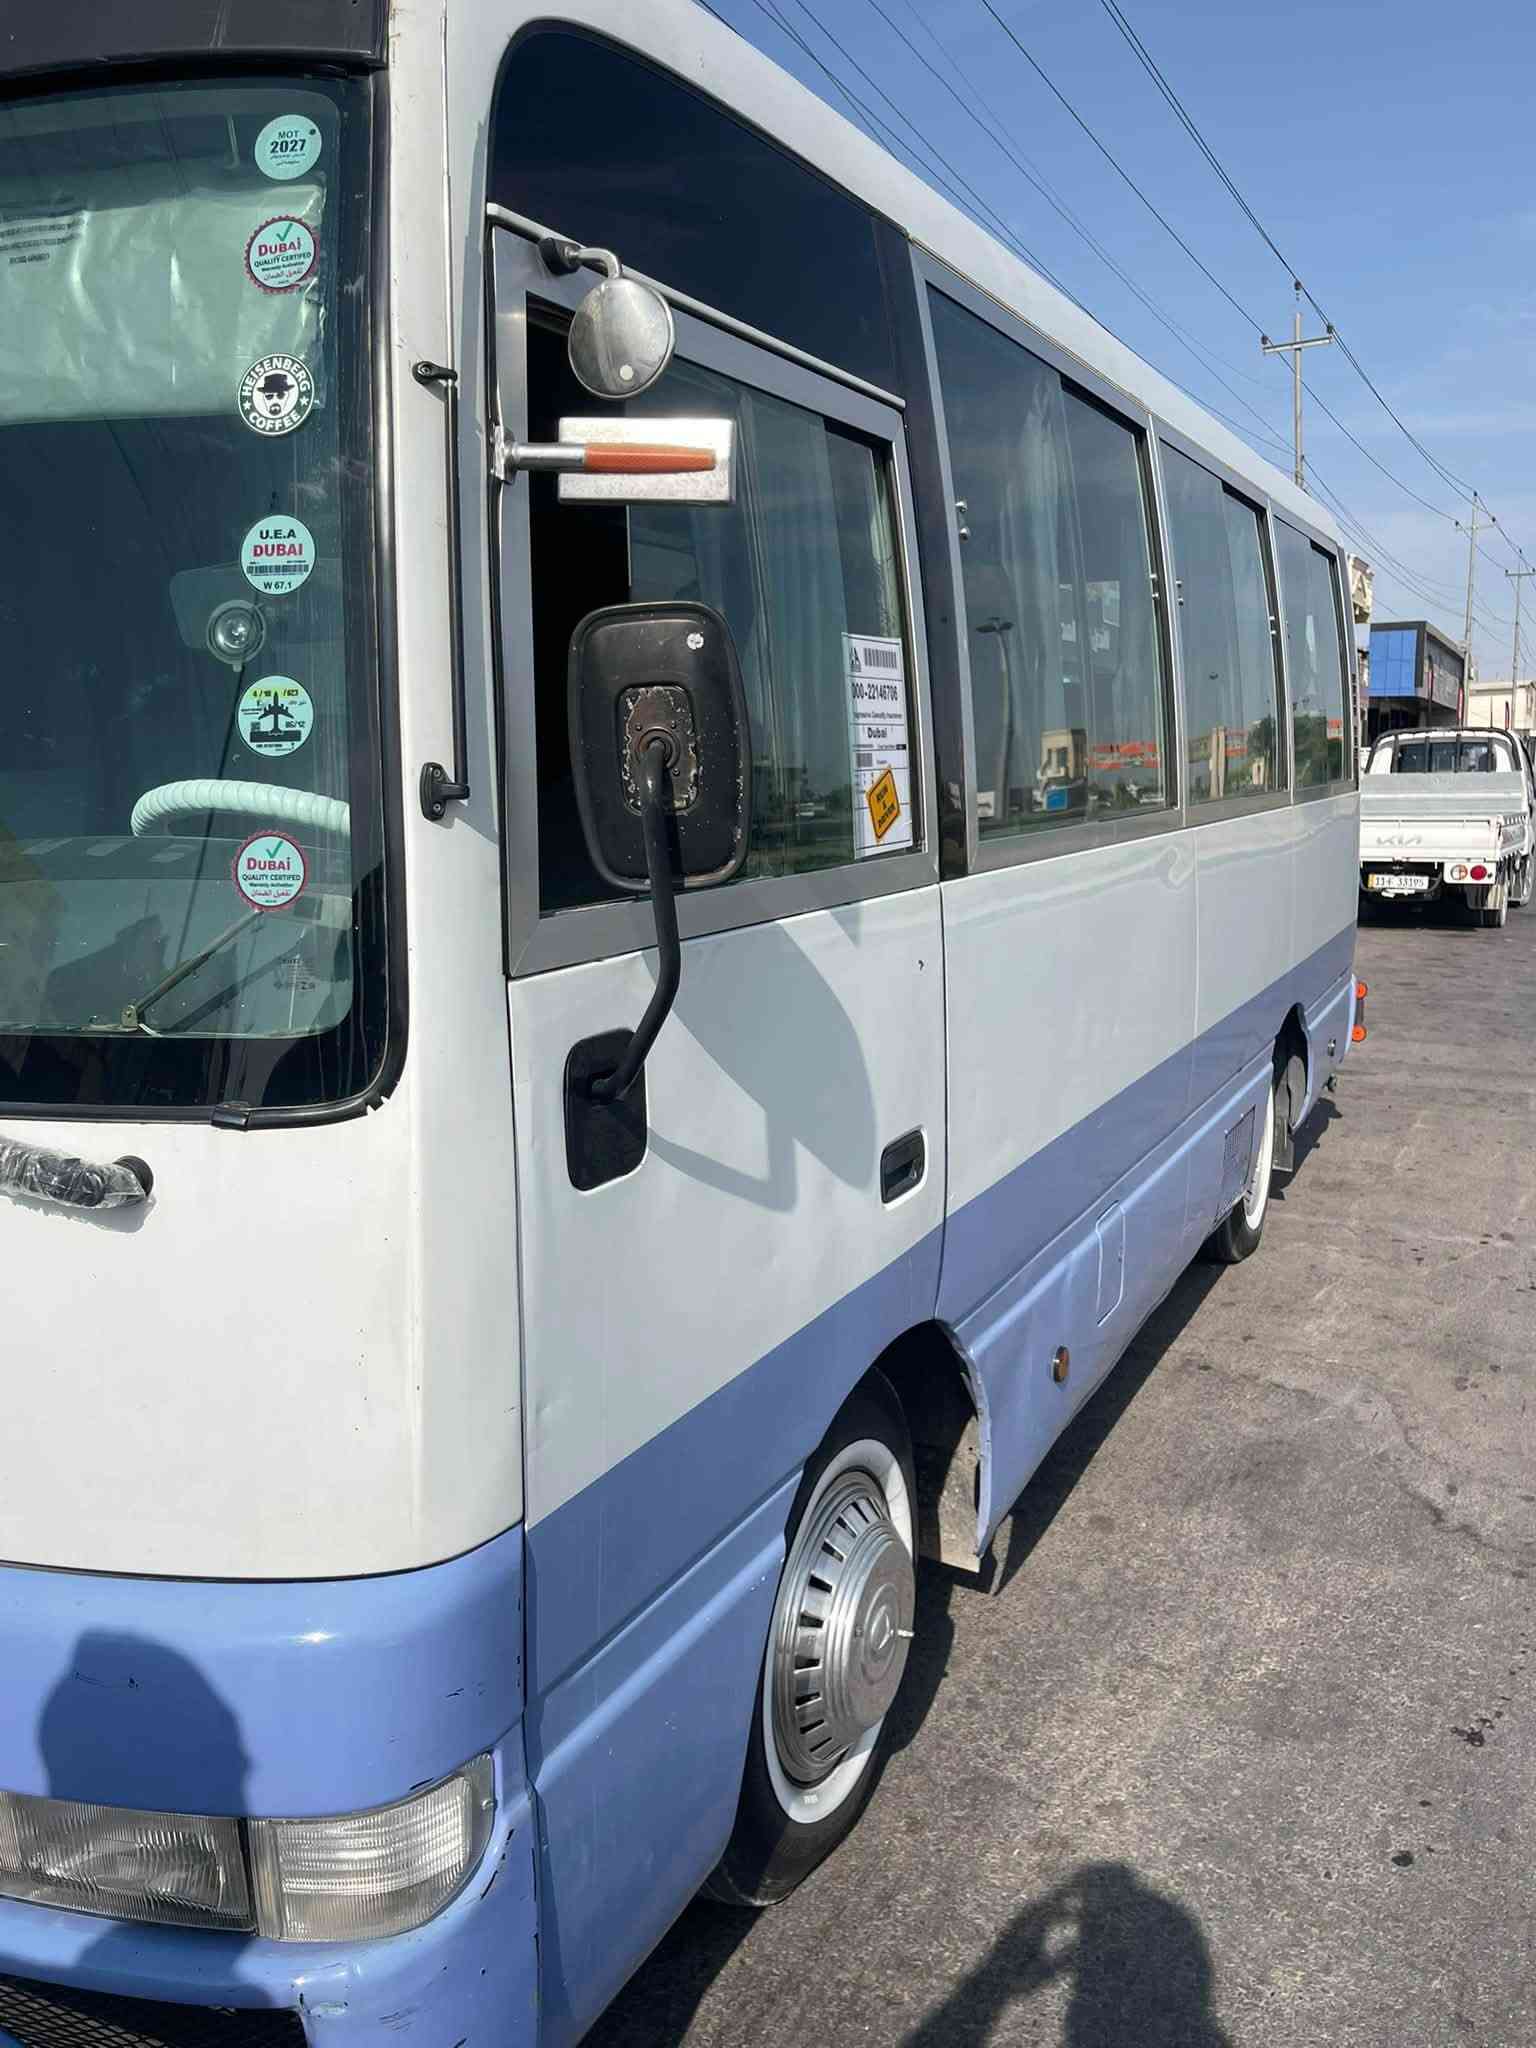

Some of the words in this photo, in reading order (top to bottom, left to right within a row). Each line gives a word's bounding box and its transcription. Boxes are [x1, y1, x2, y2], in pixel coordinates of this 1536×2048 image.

[278, 130, 300, 139] MOT
[270, 139, 307, 154] 2027
[254, 255, 281, 268] QUALITY
[241, 357, 311, 397] HEISENBERG
[248, 409, 301, 431] COFFEE
[259, 529, 297, 540] U.E.A
[253, 543, 304, 558] DUBAI
[263, 581, 273, 590] W
[867, 727, 888, 739] Dubai
[242, 873, 269, 882] QUALITY
